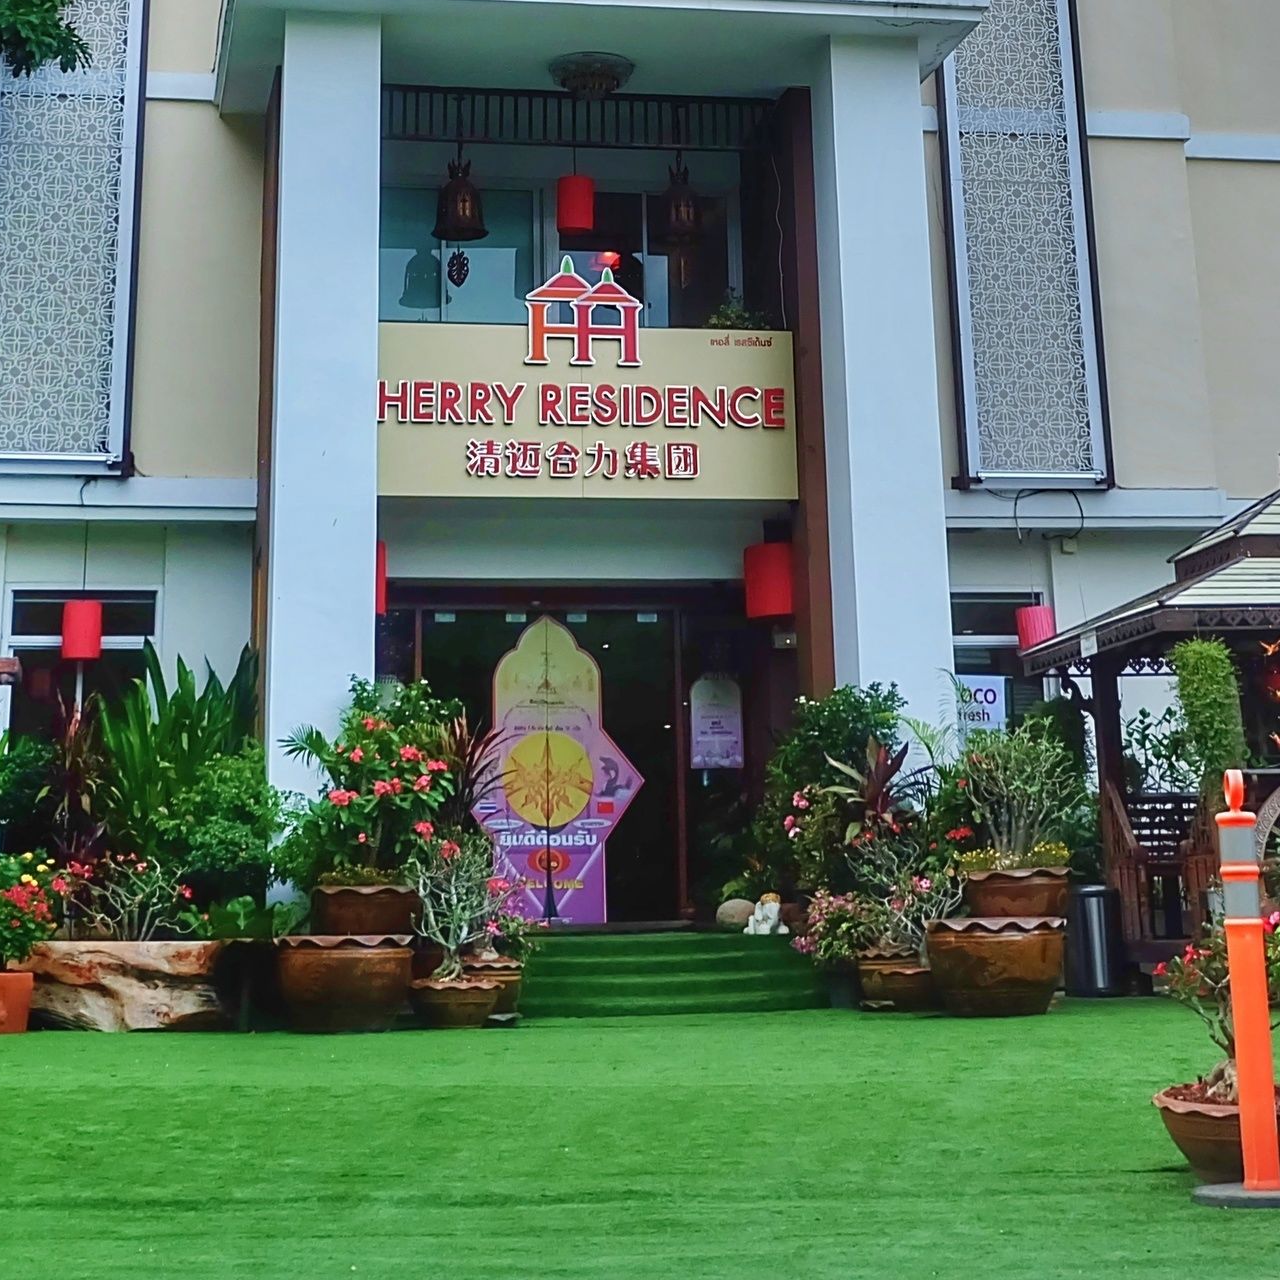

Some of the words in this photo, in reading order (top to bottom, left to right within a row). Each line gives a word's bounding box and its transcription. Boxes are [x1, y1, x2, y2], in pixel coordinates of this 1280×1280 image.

[377, 380, 527, 424] HERRY
[539, 383, 785, 428] RESIDENCE
[466, 439, 700, 479] 清迈合力集团
[956, 688, 997, 704] OCO
